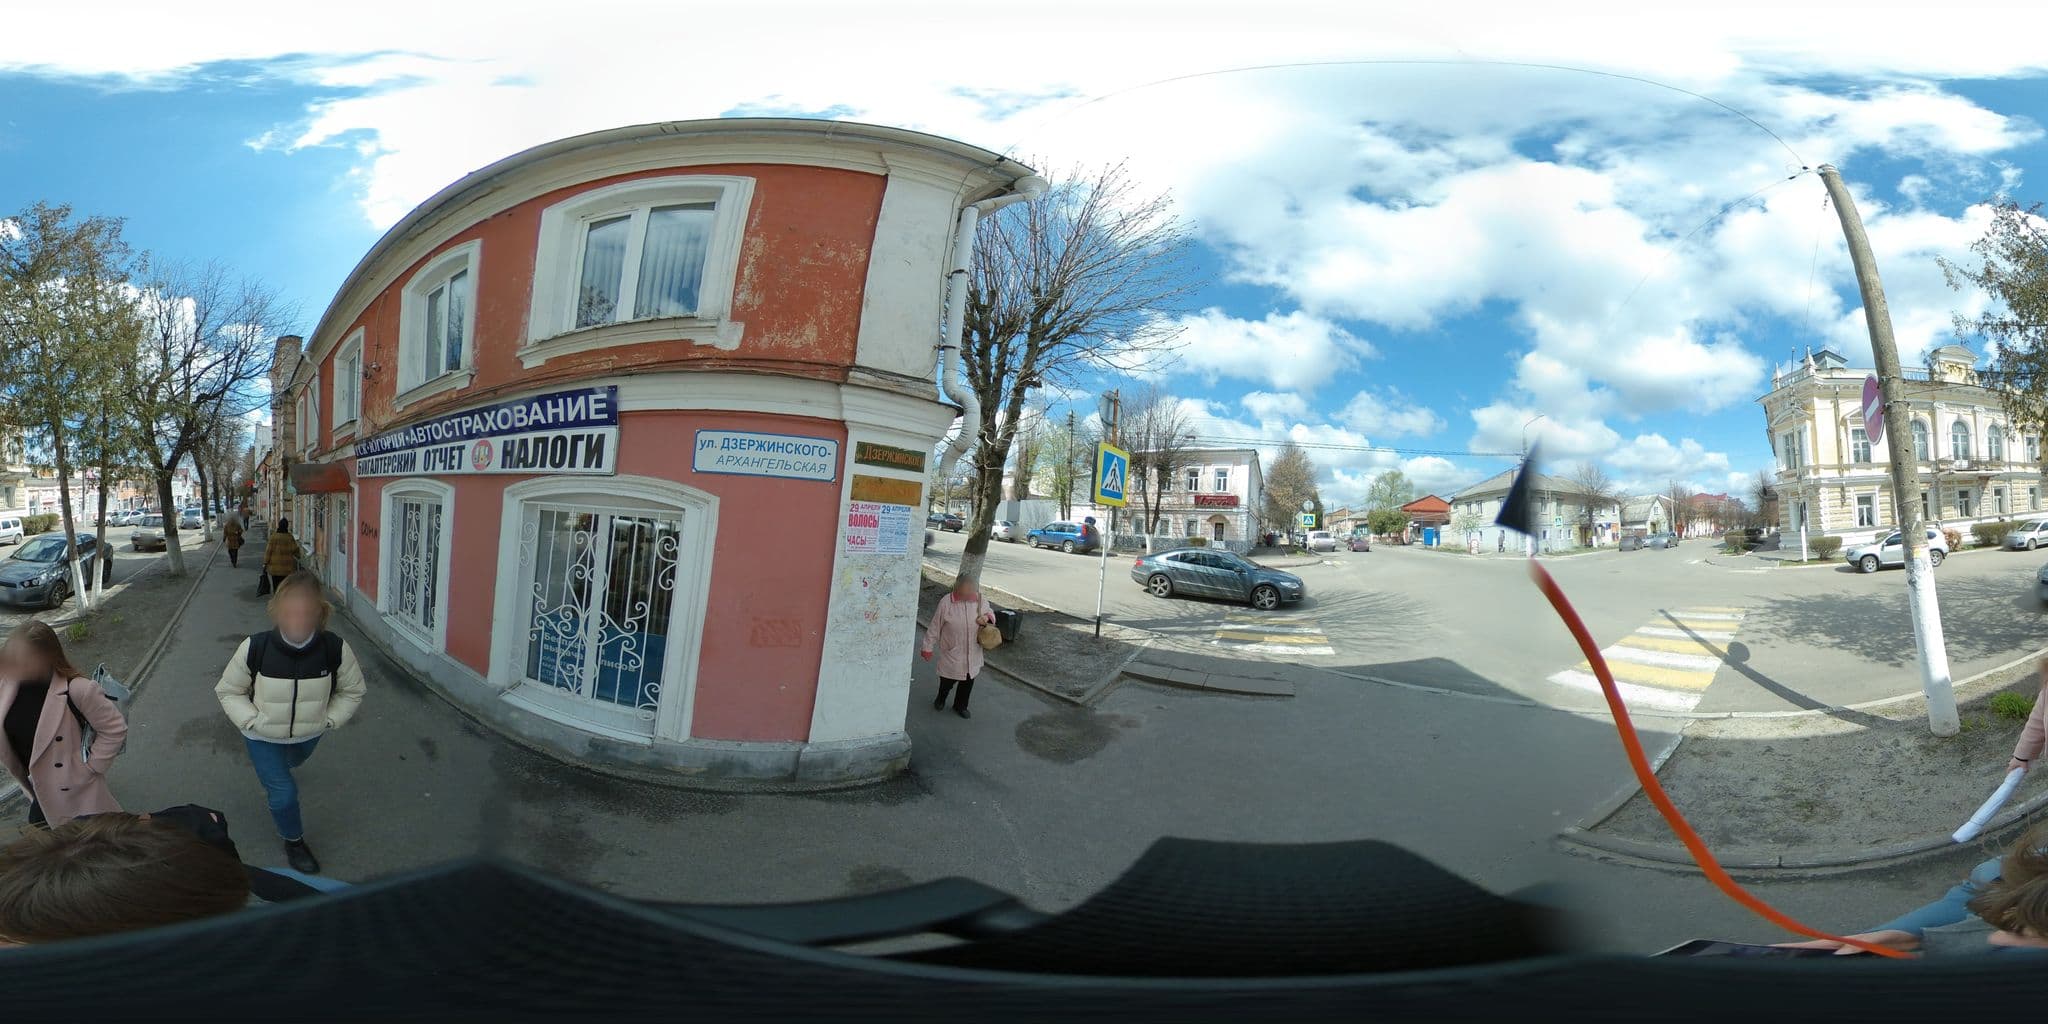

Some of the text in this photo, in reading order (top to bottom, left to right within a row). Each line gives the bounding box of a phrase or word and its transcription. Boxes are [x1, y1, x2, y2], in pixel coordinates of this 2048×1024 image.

[409, 393, 608, 444] АВТОСТРАХОВАНИЕ
[423, 444, 466, 472] ОТЧЕТ
[501, 433, 606, 469] НАЛОГИ
[698, 437, 832, 457] ул. ДЗЕРЖИНСКОГО-
[715, 454, 827, 474] АРХАНГЕЛЬСКАЯ
[850, 503, 859, 512] 29
[881, 505, 891, 514] 29
[848, 512, 880, 528] ВОЛОСЫ
[847, 535, 867, 545] ЧАСЫ
